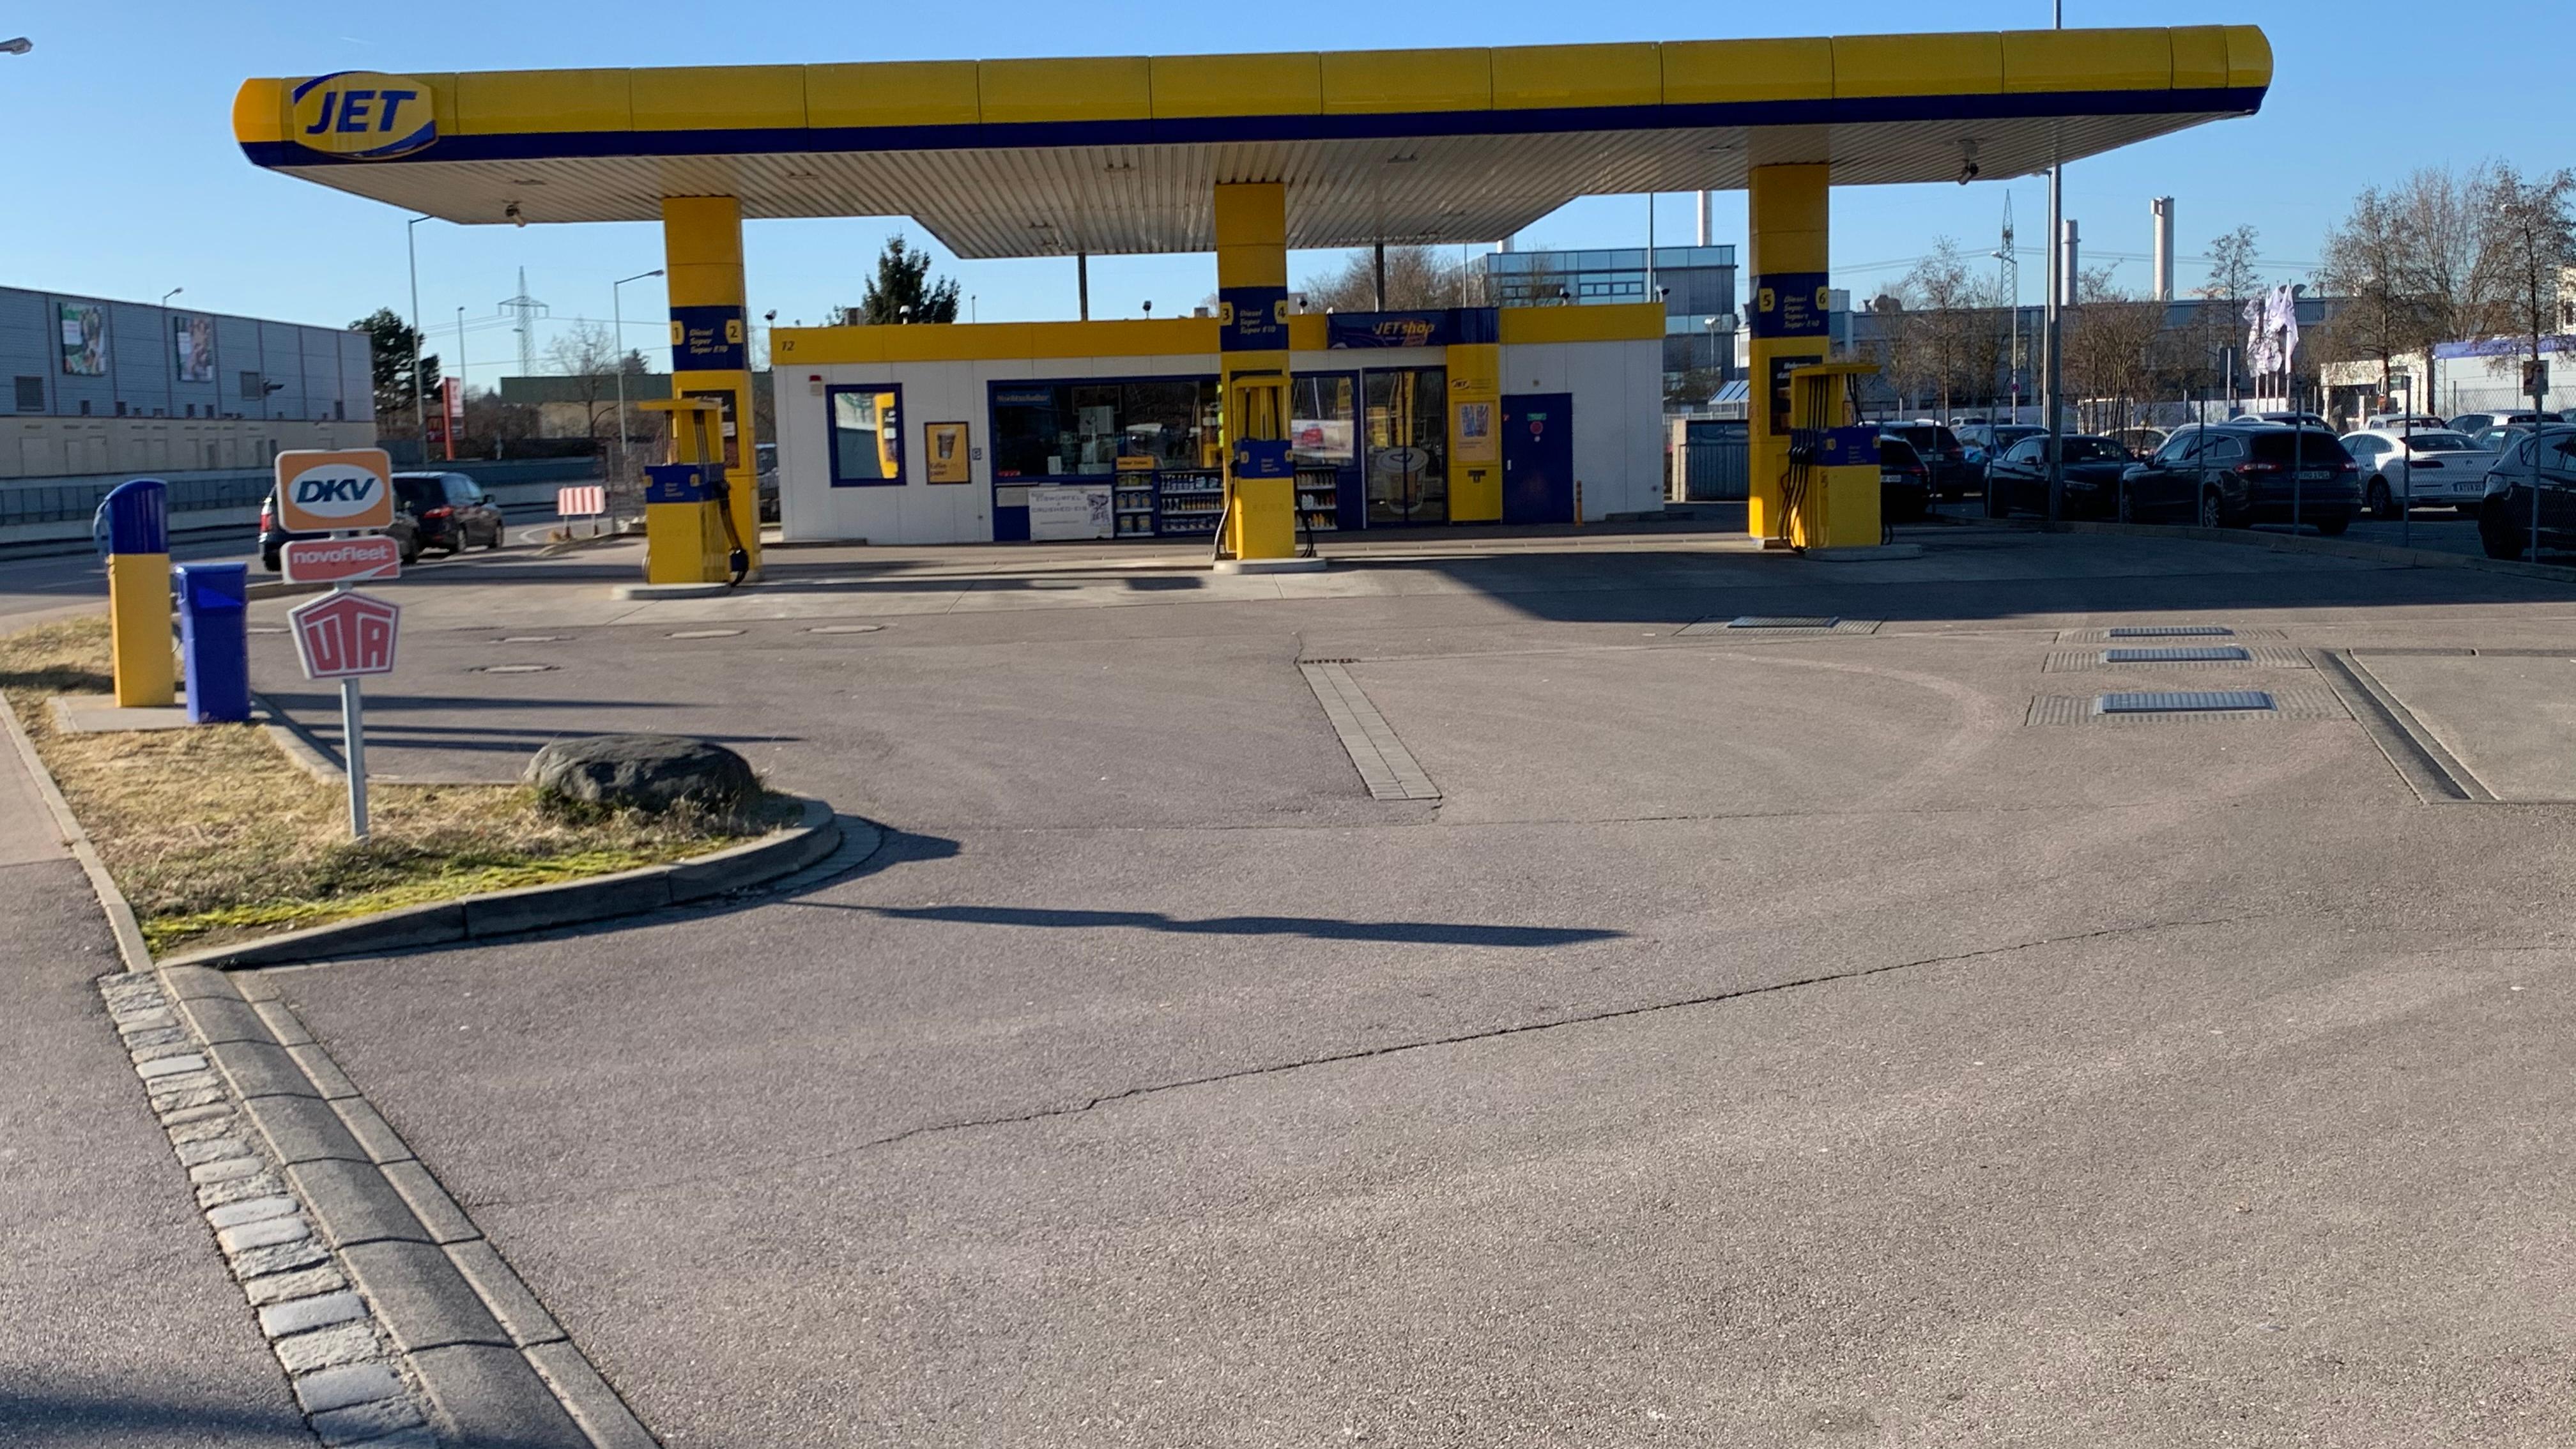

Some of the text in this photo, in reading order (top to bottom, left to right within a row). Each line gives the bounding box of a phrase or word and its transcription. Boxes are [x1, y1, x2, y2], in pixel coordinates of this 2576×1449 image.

[306, 90, 417, 134] JET
[1763, 294, 1772, 307] 5
[1819, 293, 1825, 304] 6
[1223, 308, 1230, 321] 3
[1239, 309, 1263, 318] Diesel
[1278, 306, 1285, 318] 4
[730, 325, 738, 338] 2
[1240, 326, 1261, 335] Super
[781, 341, 795, 351] 12
[296, 477, 378, 503] DKV
[303, 598, 392, 671] UTA
